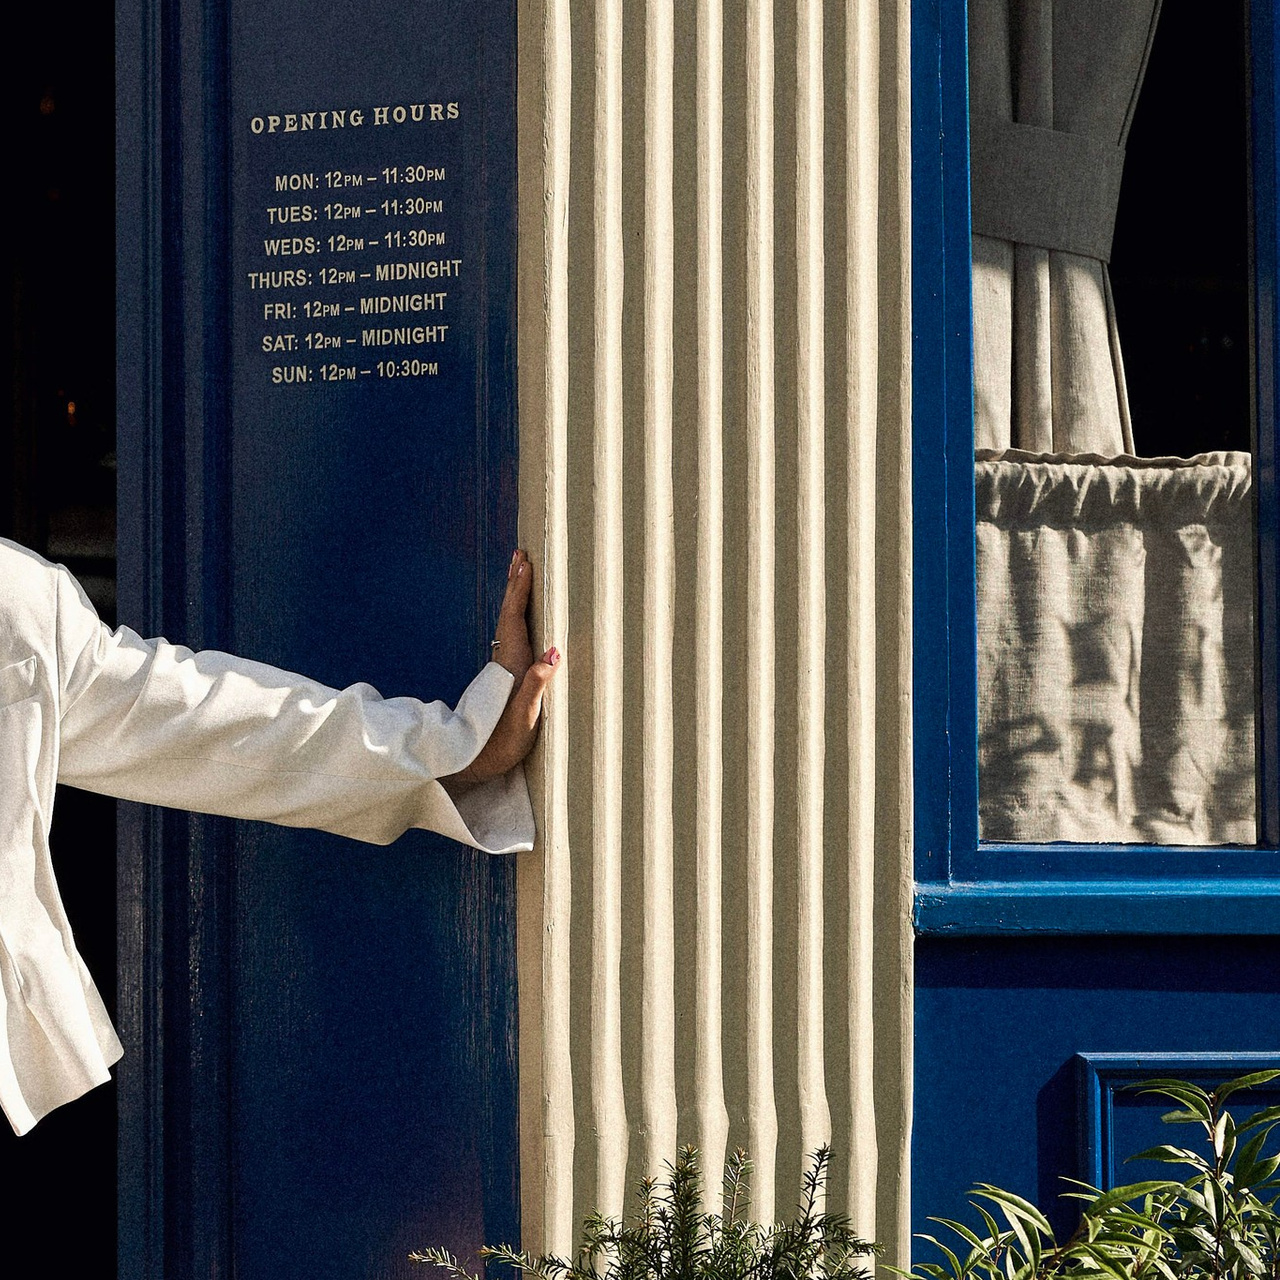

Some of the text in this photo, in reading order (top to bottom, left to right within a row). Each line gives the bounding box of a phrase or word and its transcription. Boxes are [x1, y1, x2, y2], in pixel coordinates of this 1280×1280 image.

[250, 102, 460, 134] OPENING HOURS
[275, 173, 320, 192] MON:
[324, 171, 363, 189] 12PM
[382, 165, 446, 184] 11:30PM
[267, 205, 318, 225] TUES:
[324, 203, 361, 220] 12PM
[381, 198, 443, 216] 11:30PM
[264, 236, 321, 256] WEDS:
[327, 234, 364, 252] 12PM
[384, 229, 446, 249] 11:30PM
[248, 269, 313, 290] THURS:
[319, 268, 356, 285] 12PM
[376, 260, 463, 281] MIDNIGHT
[264, 303, 297, 320] FRI:
[303, 301, 340, 319] 12PM
[360, 293, 447, 315] MIDNIGHT
[262, 334, 299, 352] SAT:
[305, 332, 341, 350] 12PM
[362, 325, 449, 346] MIDNIGHT
[272, 365, 313, 384] SUN:
[319, 364, 356, 381] 12PM
[377, 359, 439, 378] 10:30PM
